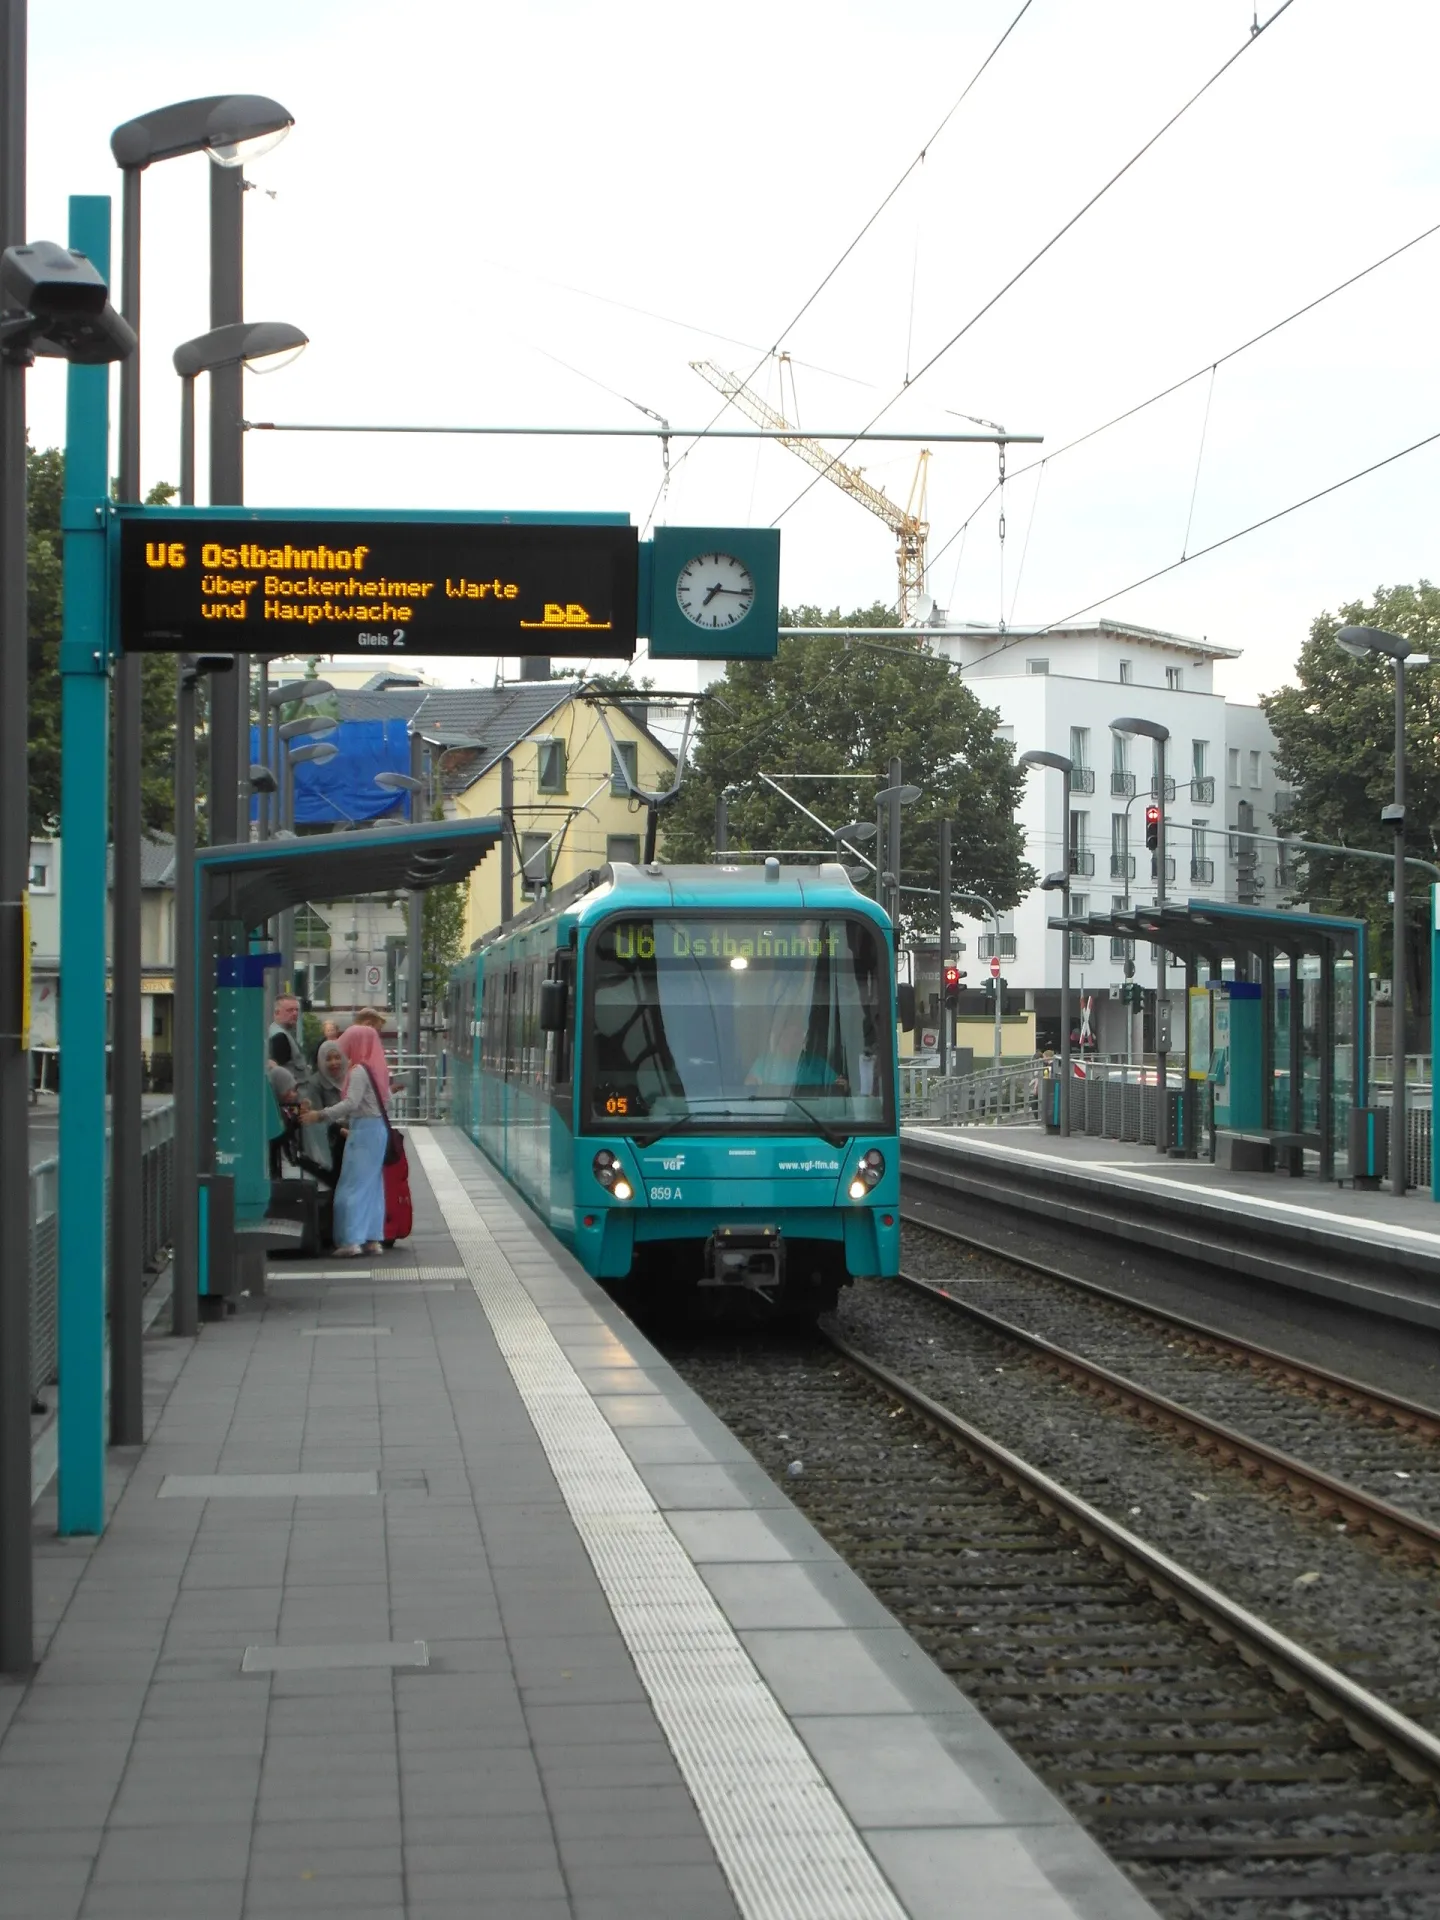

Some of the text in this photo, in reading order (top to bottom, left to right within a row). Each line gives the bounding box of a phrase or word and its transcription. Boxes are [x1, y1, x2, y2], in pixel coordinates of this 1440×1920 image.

[145, 543, 369, 570] U6 Ostbahnhof
[201, 575, 519, 599] über Bockenheimer Warte
[201, 600, 412, 625] und Hauptwache
[358, 629, 405, 646] Gleis 2
[616, 924, 840, 958] U6 Ostbahnhof
[606, 1098, 628, 1115] 05
[778, 1161, 839, 1172] www.vgf-ffm.de
[650, 1187, 682, 1200] 859 A
